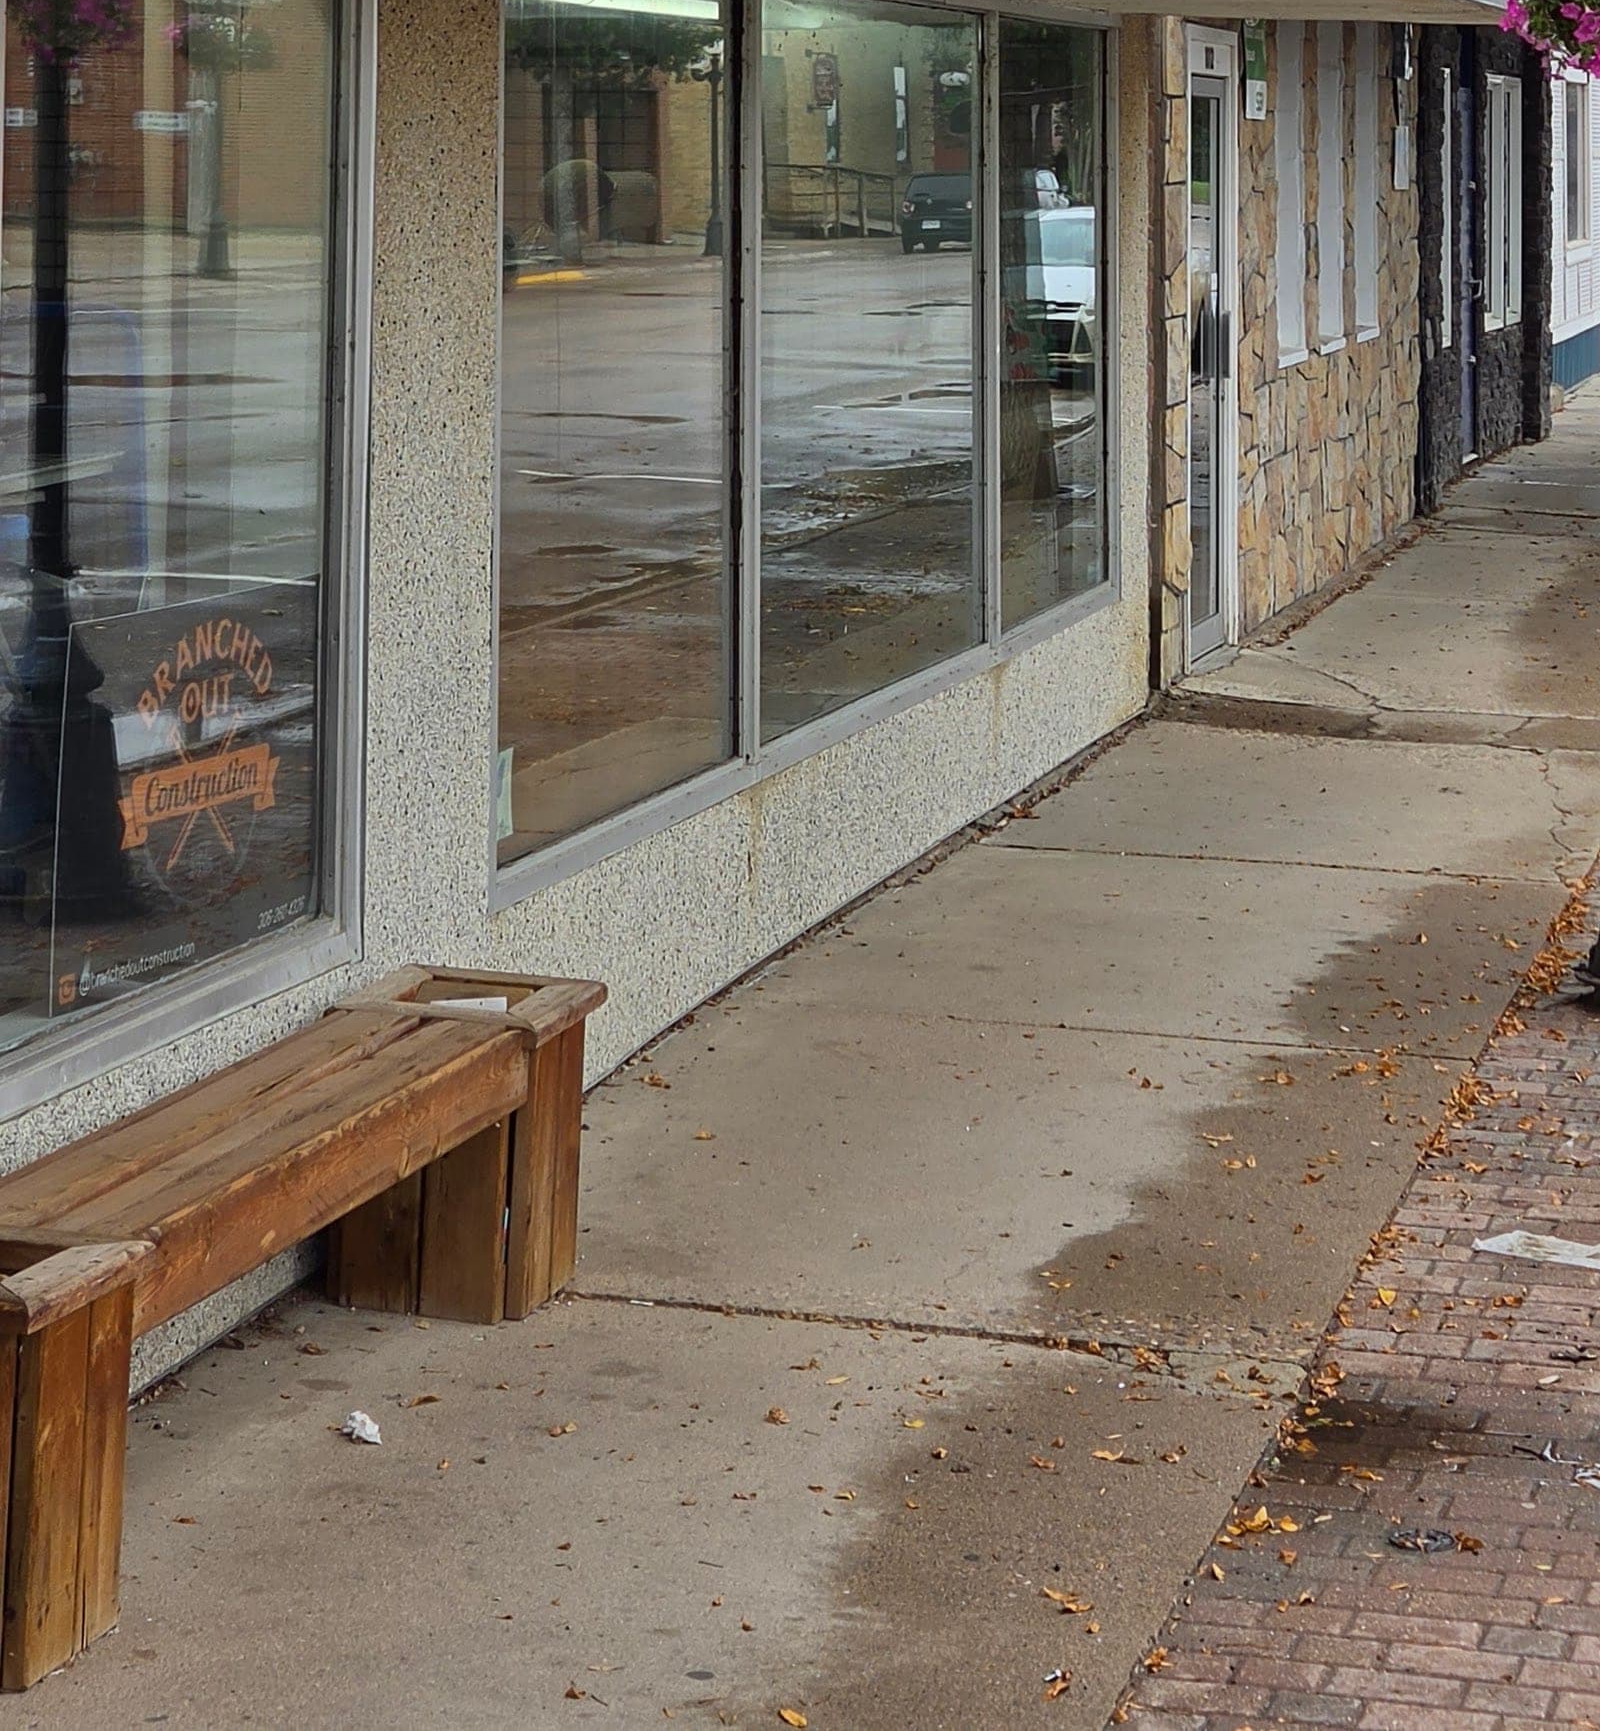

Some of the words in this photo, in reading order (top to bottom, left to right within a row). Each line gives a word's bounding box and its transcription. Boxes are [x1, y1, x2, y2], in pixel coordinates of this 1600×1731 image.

[137, 618, 273, 730] BRANCHED
[179, 672, 235, 724] OUT
[144, 757, 258, 817] Construction
